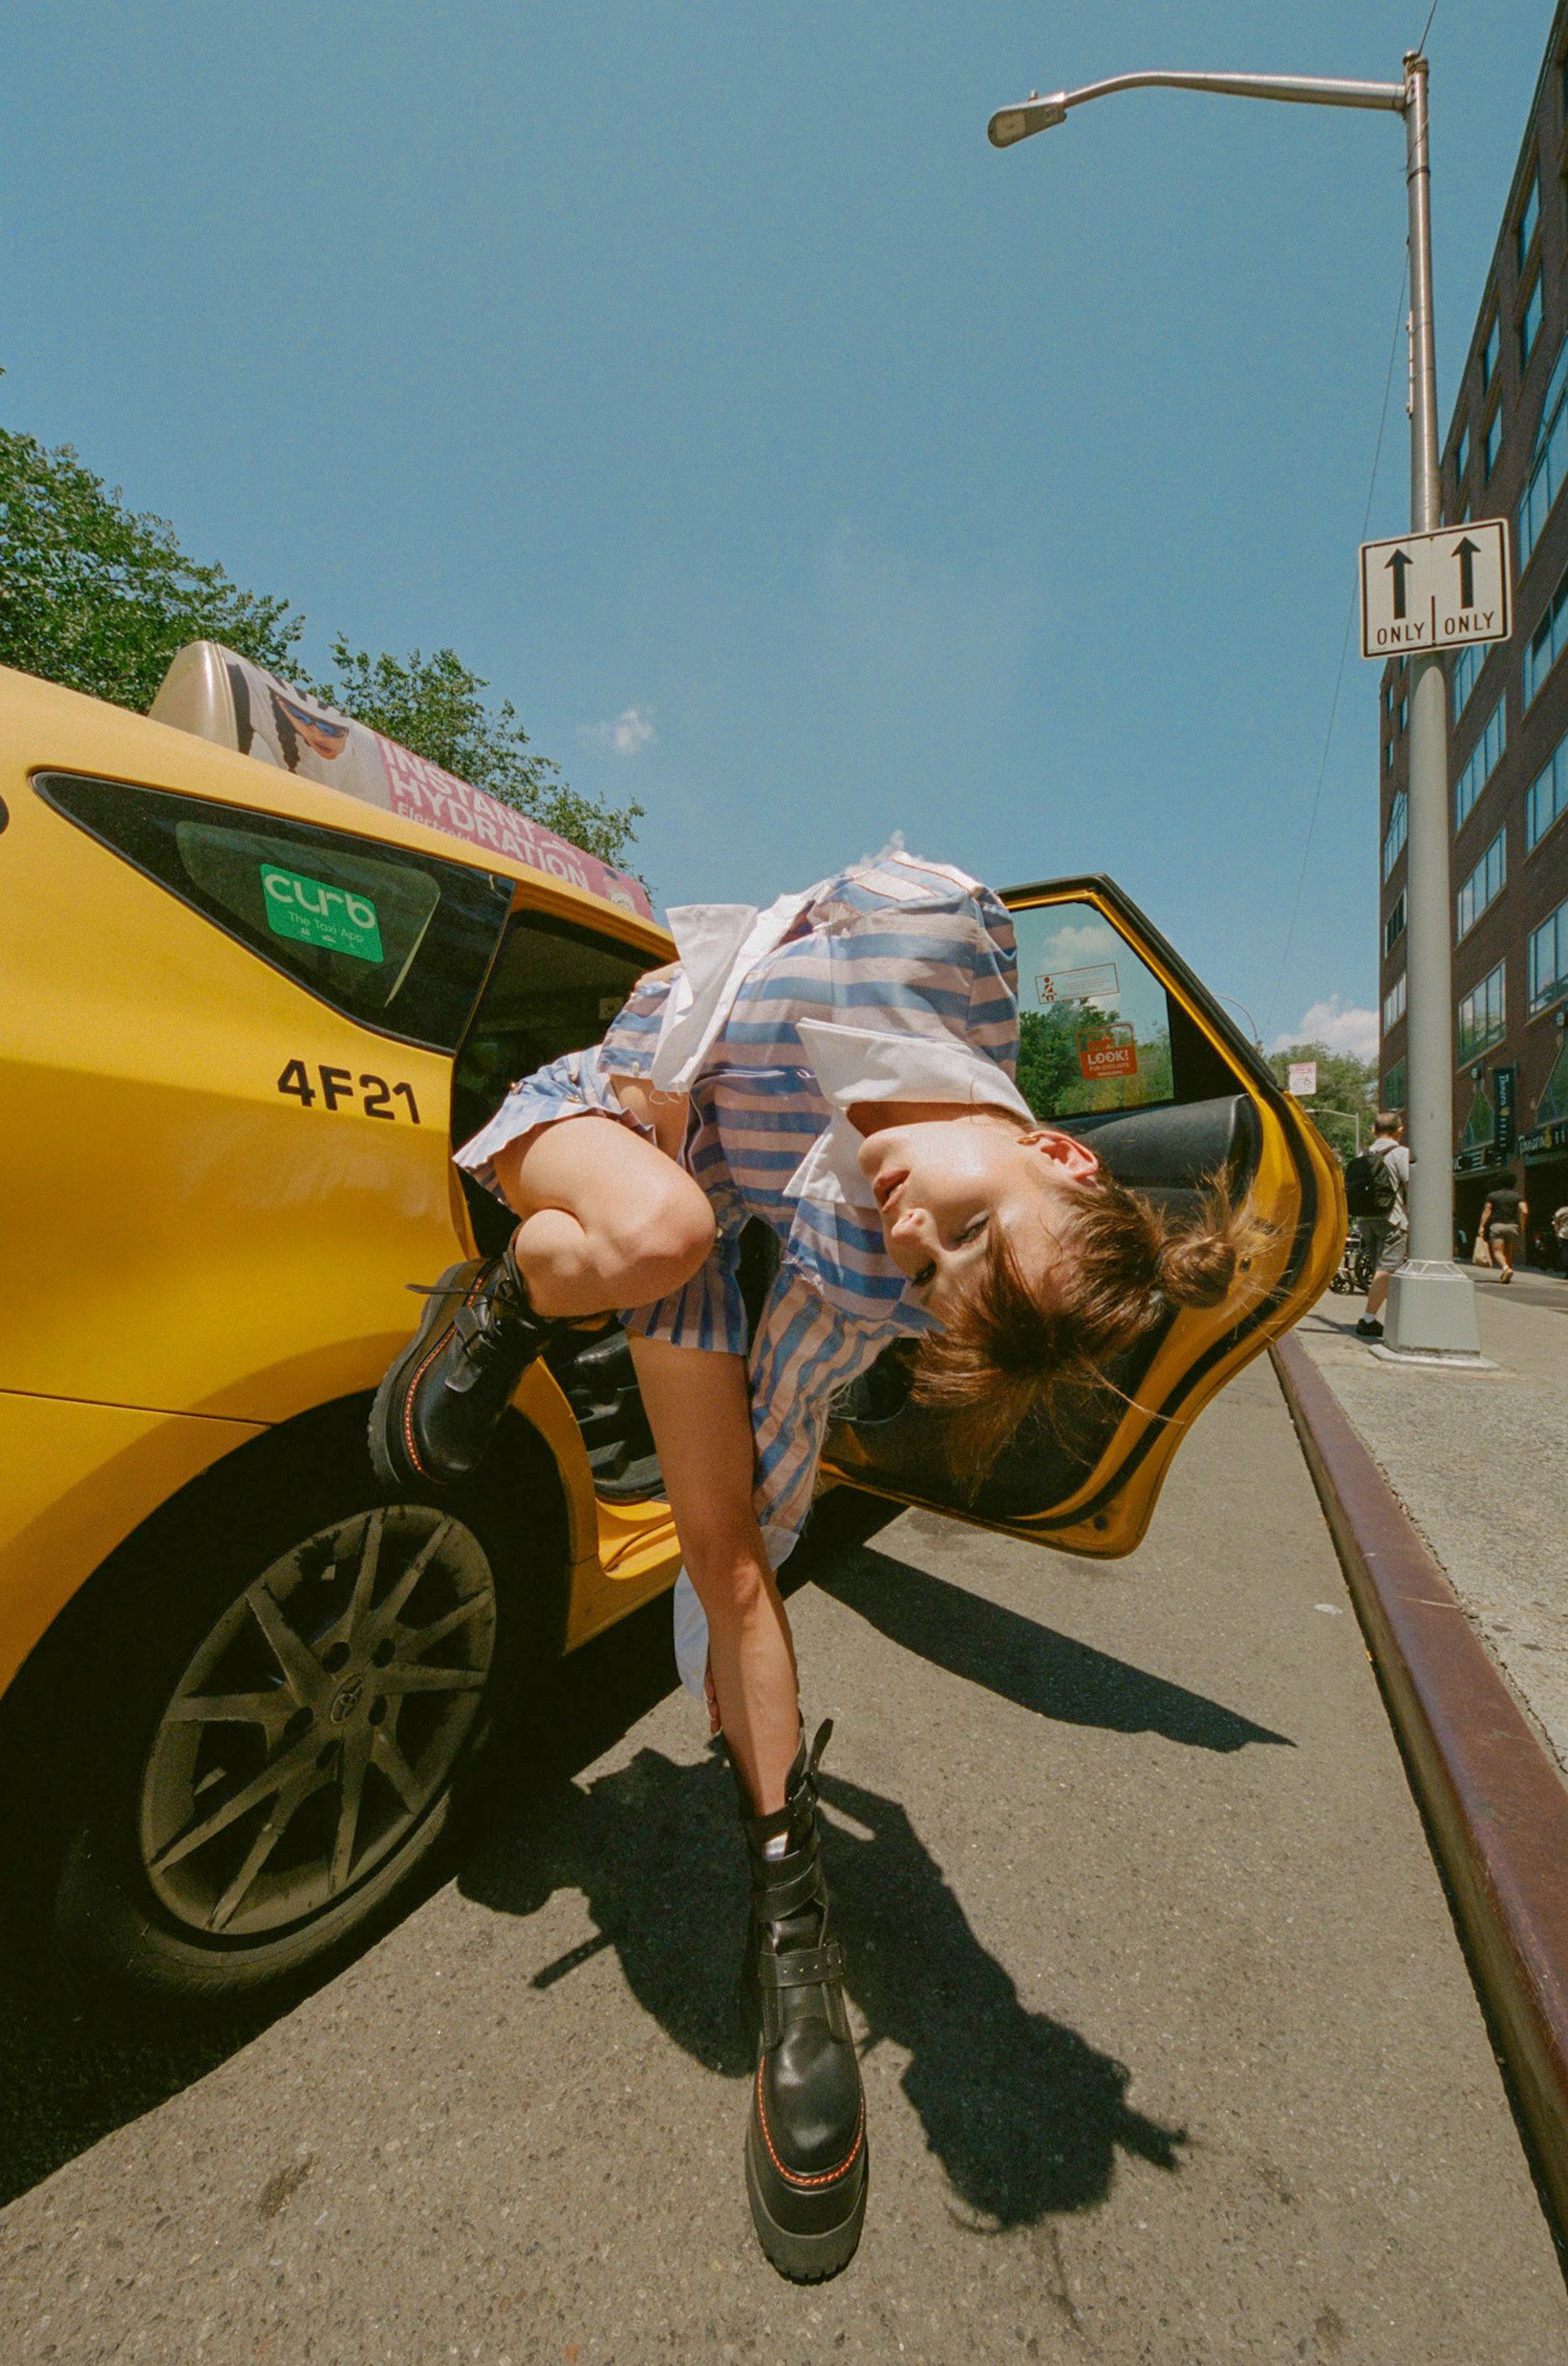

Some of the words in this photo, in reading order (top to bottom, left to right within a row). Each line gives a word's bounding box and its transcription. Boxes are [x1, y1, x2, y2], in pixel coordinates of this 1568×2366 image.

[1377, 622, 1425, 645] ONLY
[1444, 612, 1494, 635] ONLY
[382, 741, 535, 843] INSTANT
[390, 766, 590, 892] HYDRATION
[265, 873, 376, 930] curb
[289, 912, 311, 927] The
[313, 918, 337, 935] Taxi
[340, 928, 364, 943] App
[1086, 1049, 1129, 1065] LOOK!
[277, 1058, 420, 1125] 4F21
